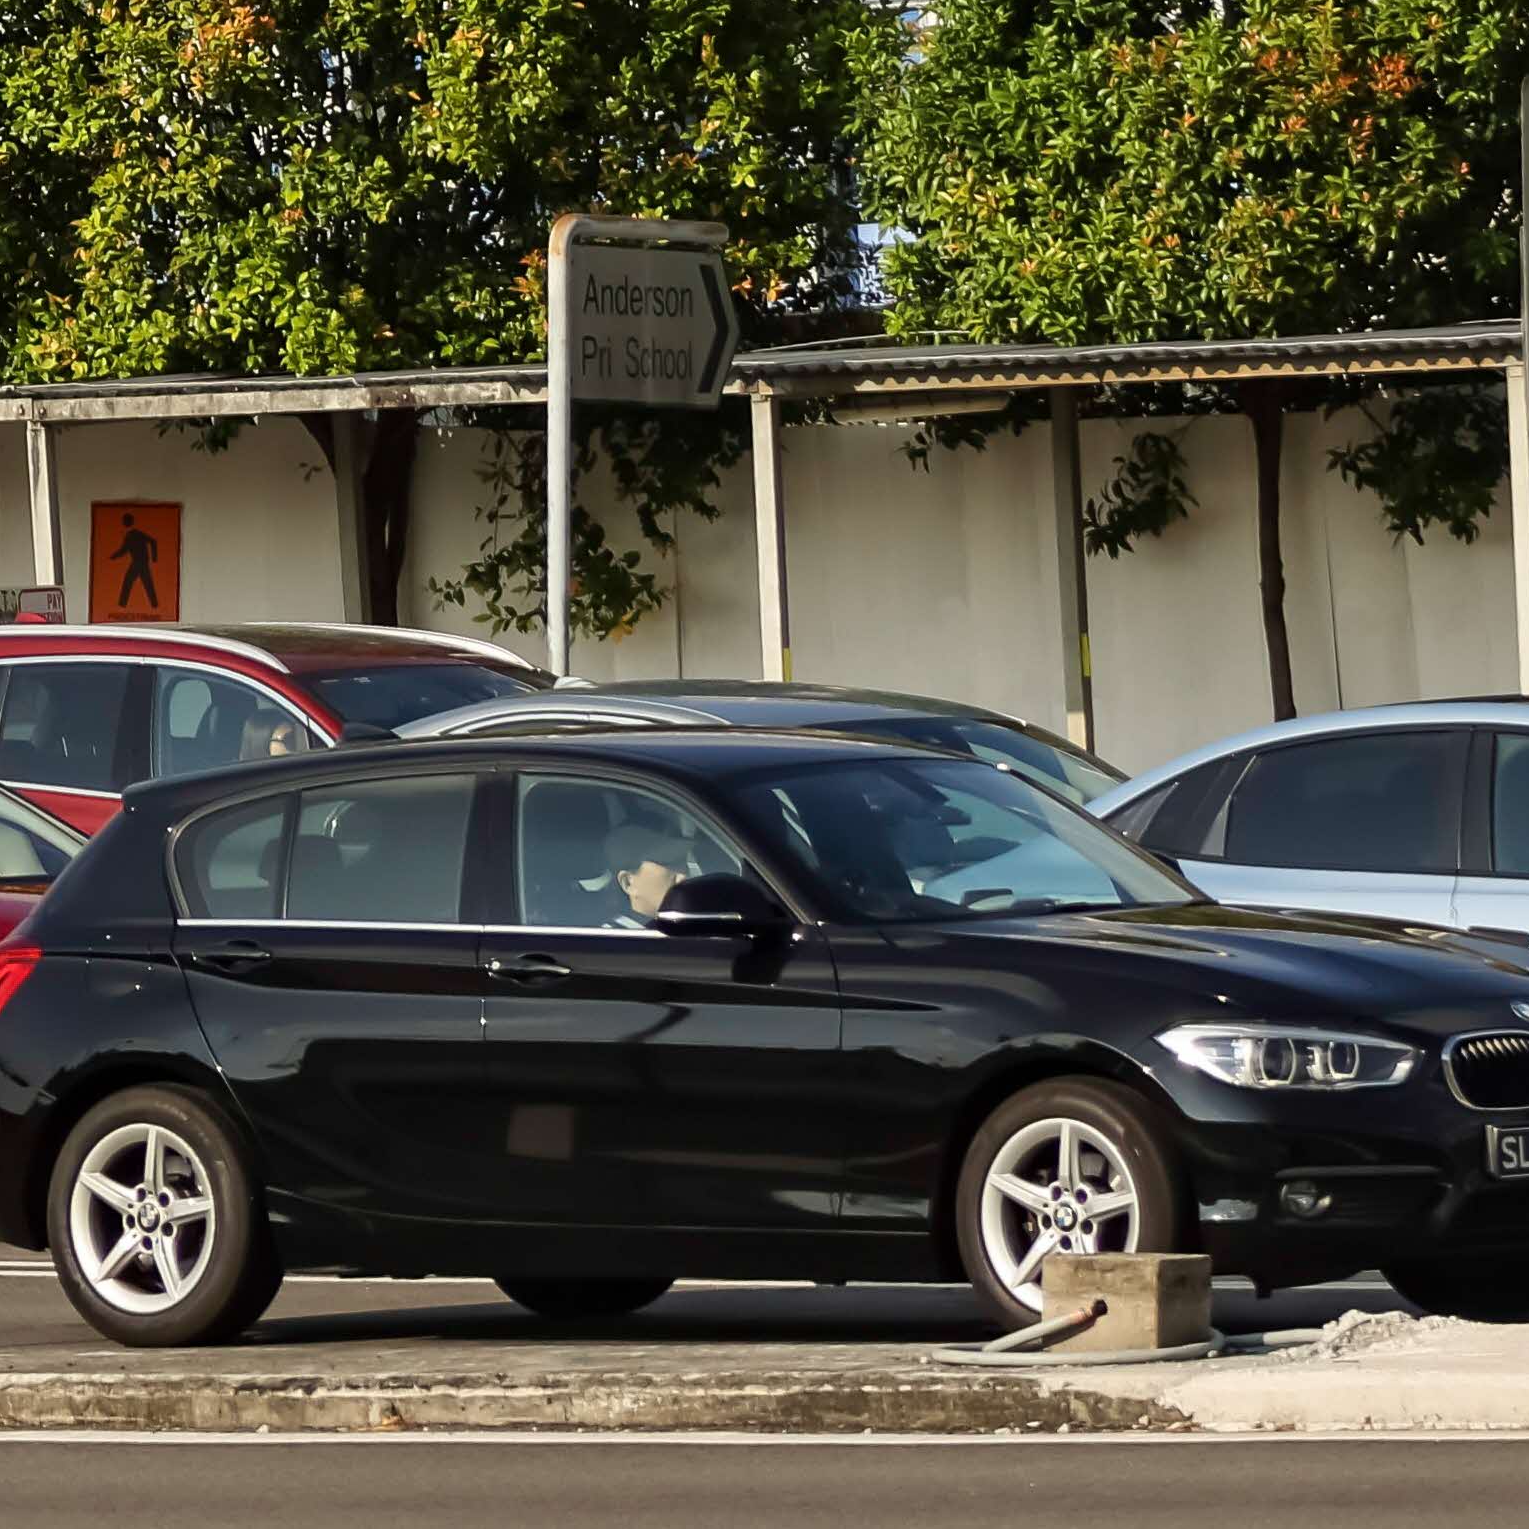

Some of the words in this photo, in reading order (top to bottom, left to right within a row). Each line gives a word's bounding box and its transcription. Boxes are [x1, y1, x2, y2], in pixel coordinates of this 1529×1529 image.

[583, 274, 694, 317] Anderson
[581, 335, 612, 378] Pri
[626, 336, 693, 381] School
